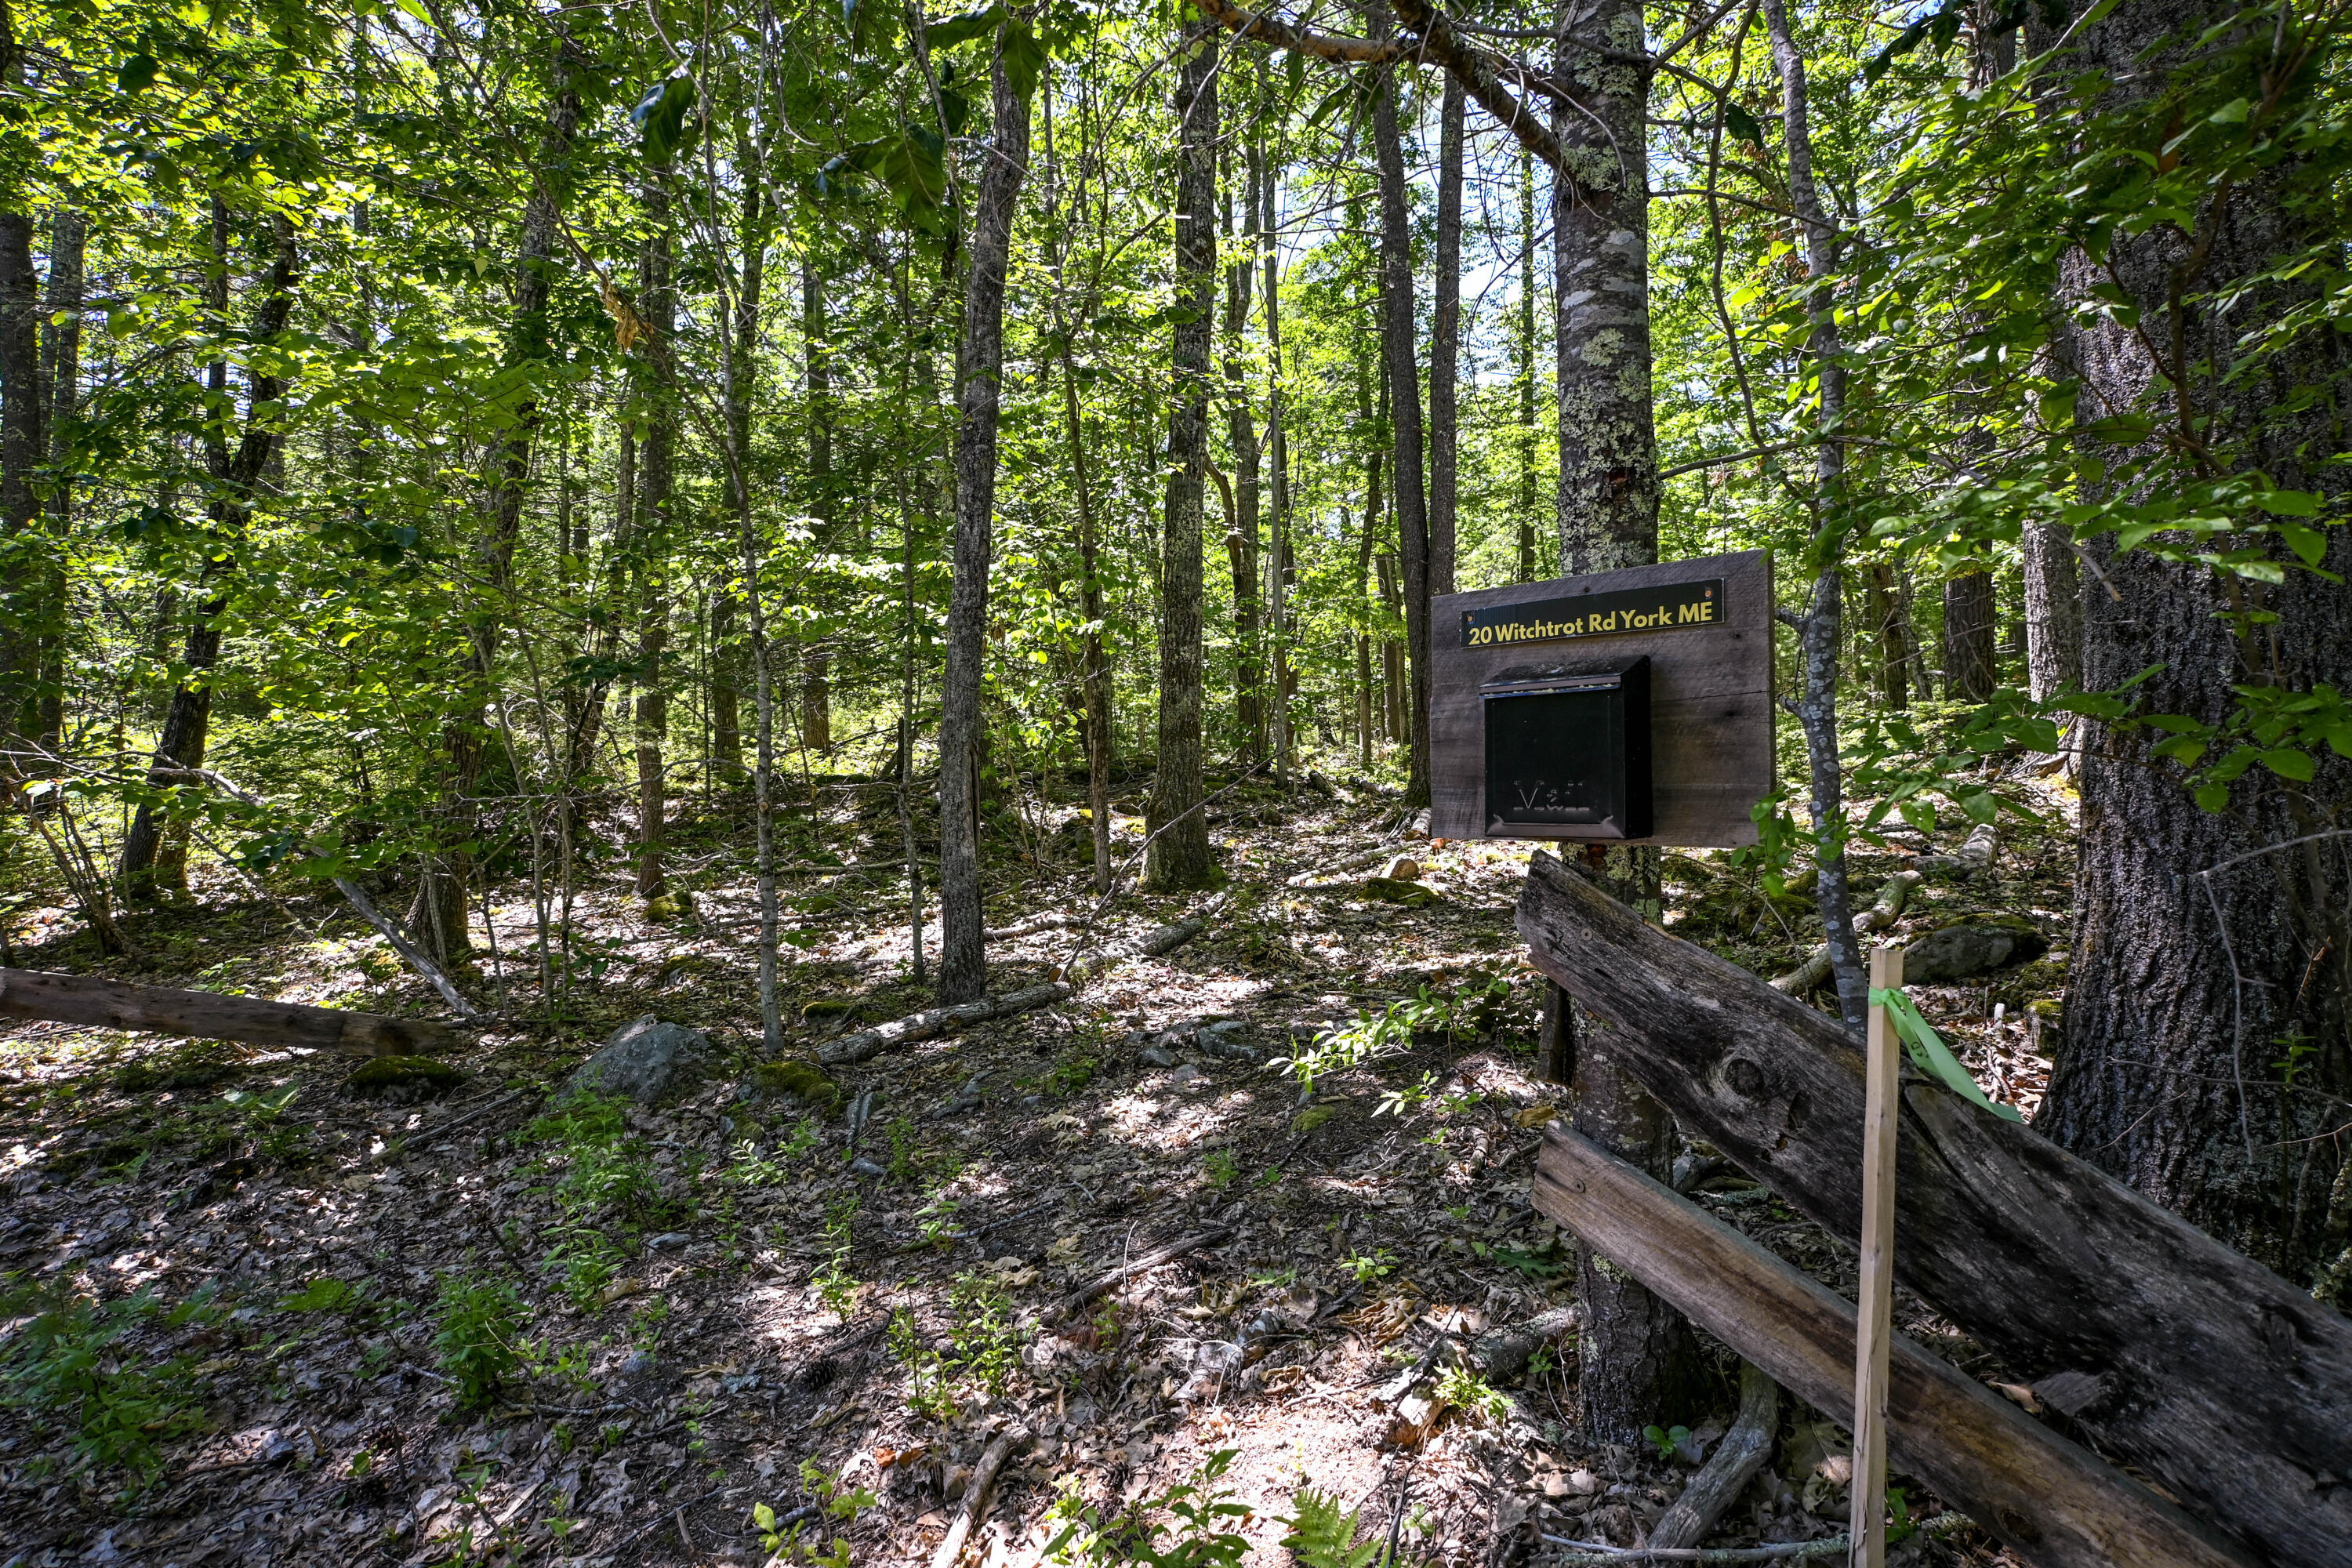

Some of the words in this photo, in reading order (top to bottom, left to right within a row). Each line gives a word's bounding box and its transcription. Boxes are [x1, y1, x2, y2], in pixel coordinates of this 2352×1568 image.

[1468, 626, 1493, 645] 20
[1494, 617, 1584, 642] Witchtrot
[1588, 611, 1616, 633] Rd
[1620, 605, 1673, 629] York
[1678, 601, 1713, 624] ME
